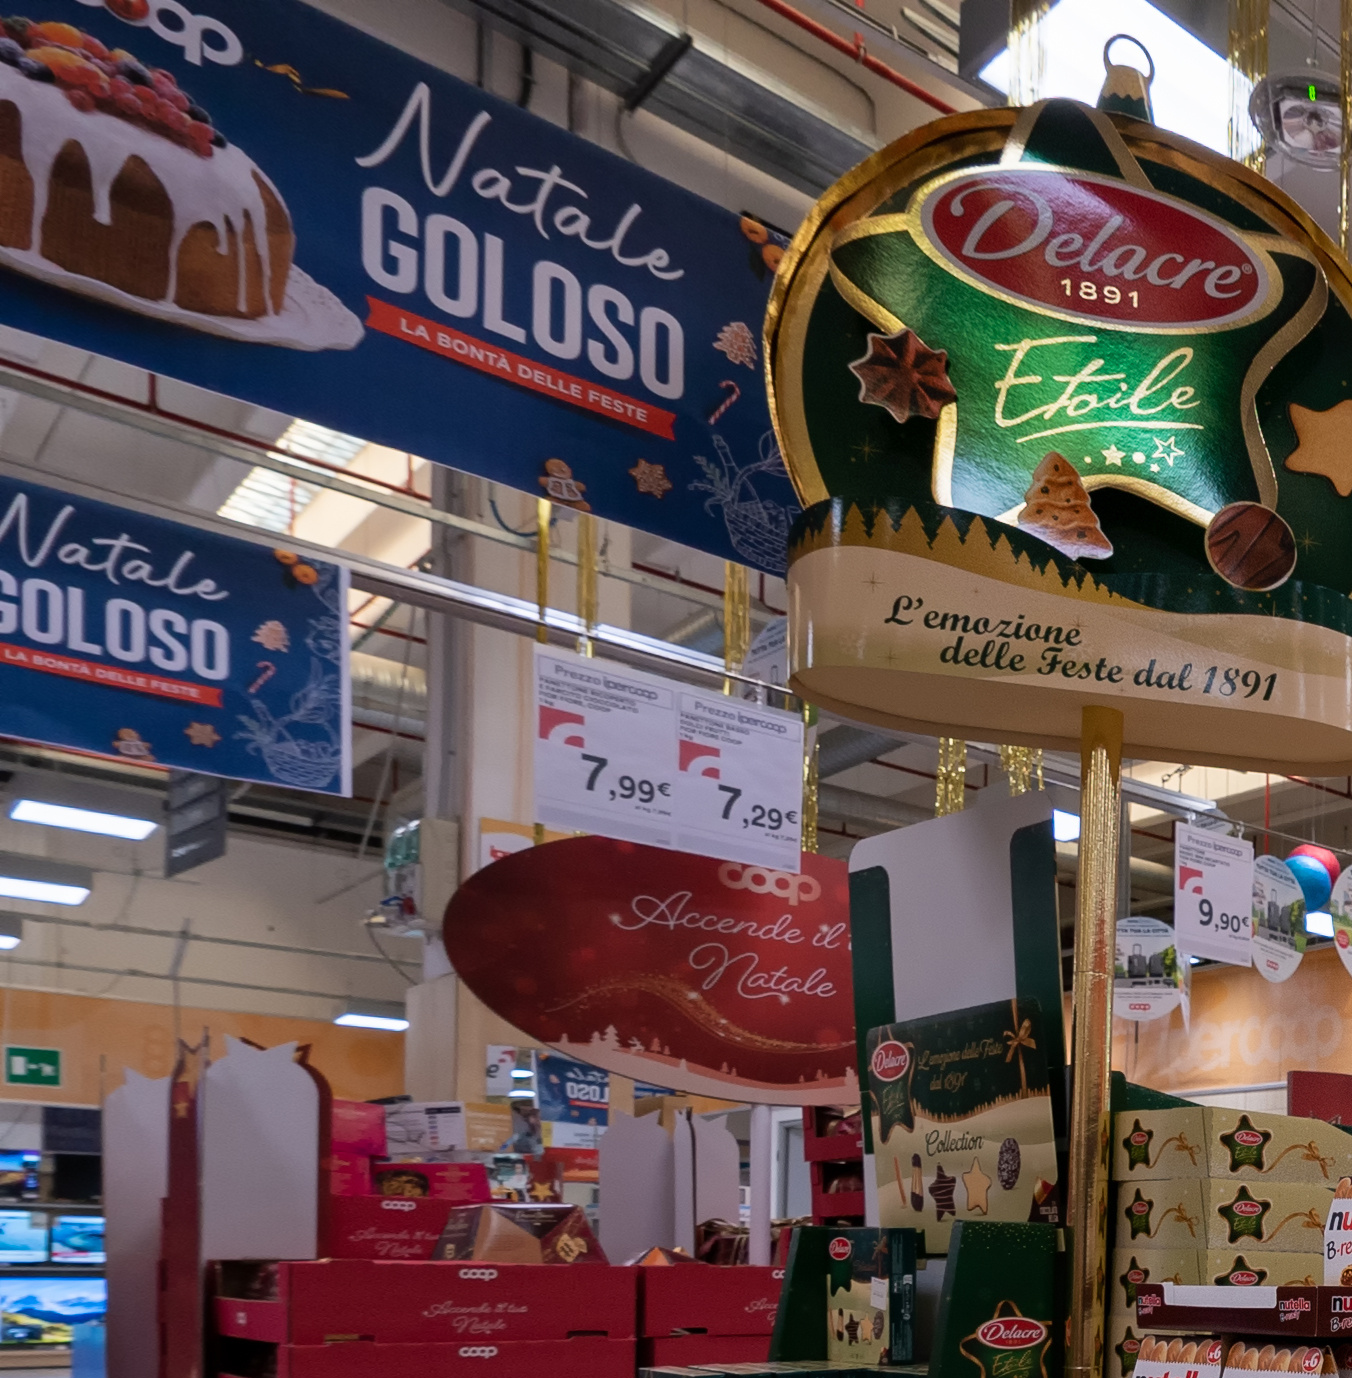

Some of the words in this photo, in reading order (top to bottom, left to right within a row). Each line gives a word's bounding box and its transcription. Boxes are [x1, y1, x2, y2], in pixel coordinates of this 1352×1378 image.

[354, 82, 684, 281] Natale
[950, 185, 1242, 299] Delacre
[361, 186, 684, 400] GOLOSO
[1060, 279, 1140, 309] 1891
[401, 318, 431, 342] LA
[437, 331, 512, 372] BONTÀ
[517, 364, 582, 399] DELLE
[588, 390, 648, 424] FESTE
[994, 336, 1200, 427] Etoile
[0, 492, 229, 600] Natale
[555, 664, 601, 687] Prezzo
[940, 638, 1025, 673] delle
[1037, 647, 1123, 683] Feste
[1134, 658, 1192, 691] dal
[1202, 663, 1277, 701] 1891
[695, 701, 735, 720] Prezzo
[581, 754, 671, 803] 7,99€
[718, 784, 798, 831] 7,29€
[718, 862, 821, 905] coop
[617, 891, 805, 944] Accende
[1199, 898, 1249, 934] 9,90€
[689, 943, 836, 999] Natale
[925, 1129, 984, 1156] Collection
[459, 1268, 498, 1281] coop
[982, 1322, 1044, 1342] Delacre
